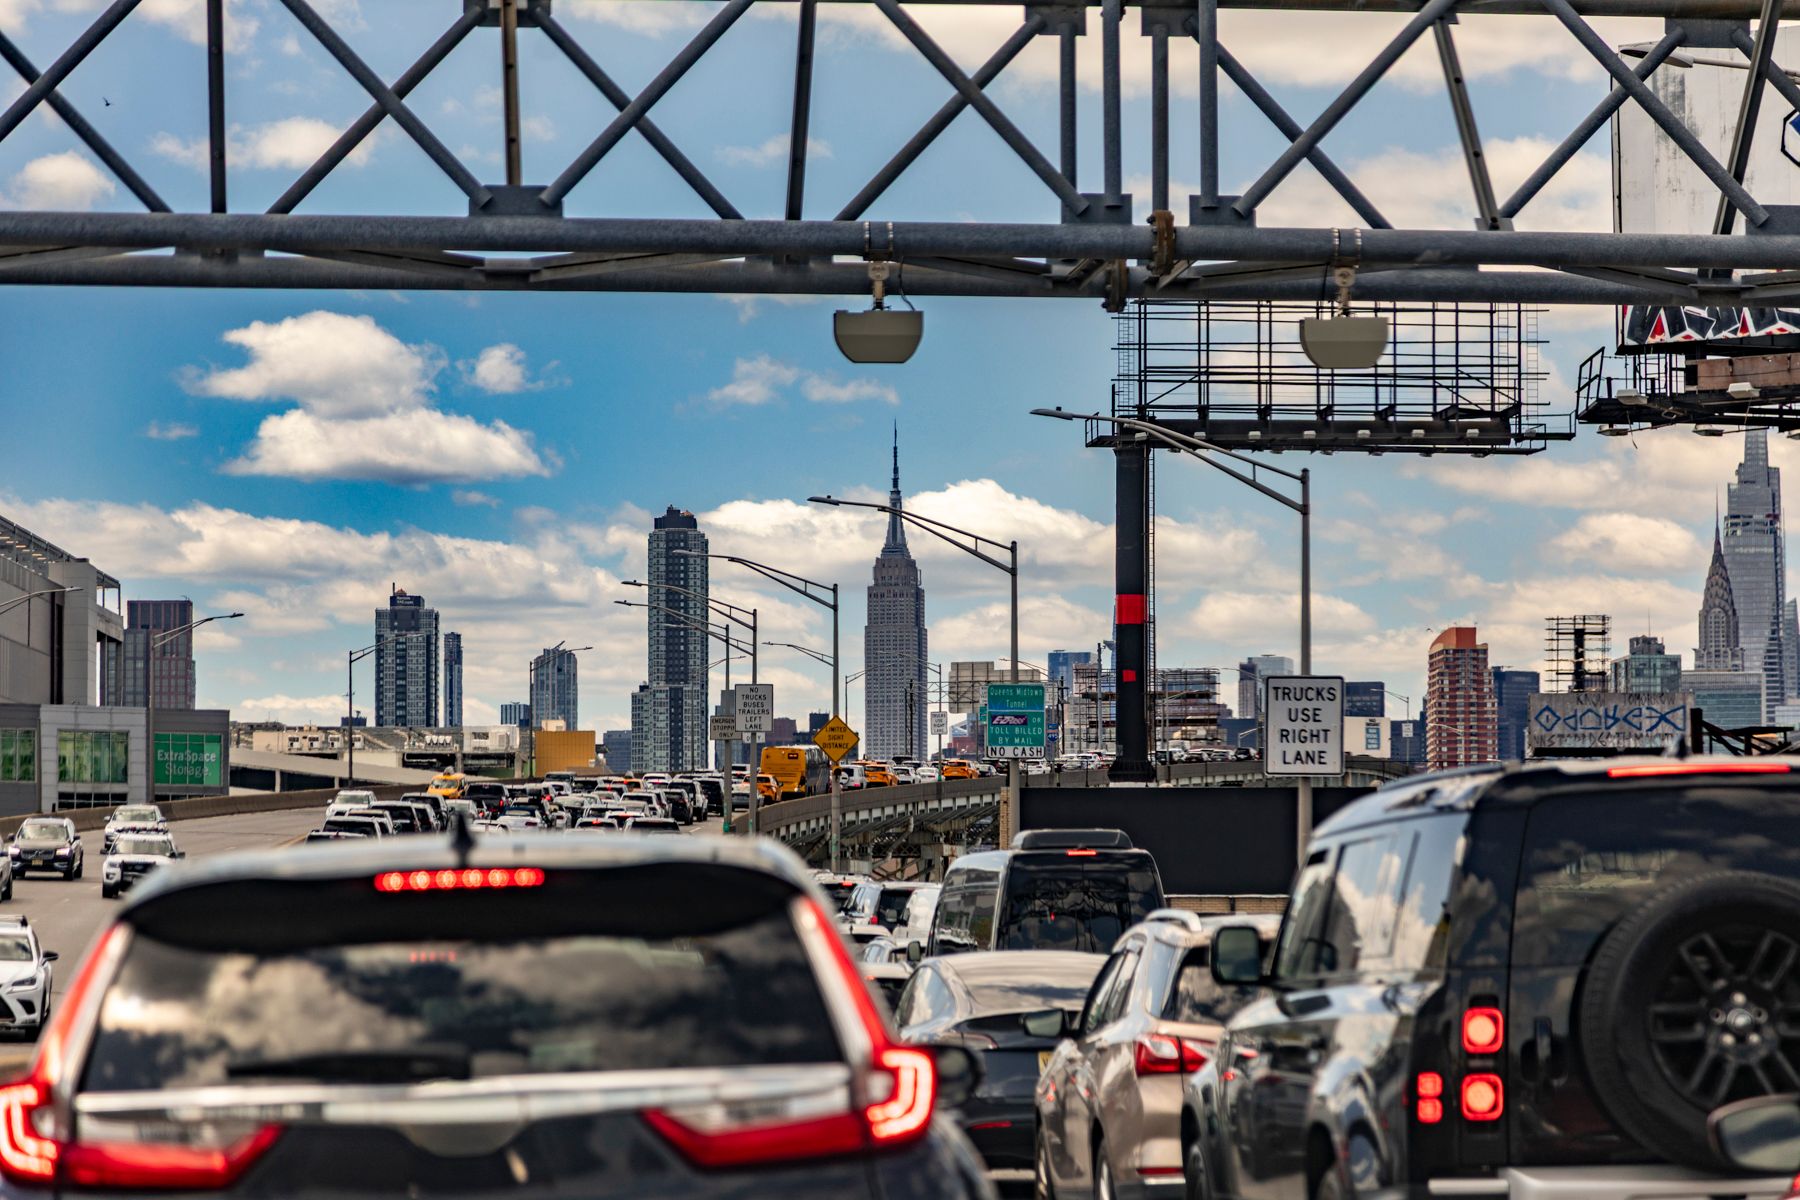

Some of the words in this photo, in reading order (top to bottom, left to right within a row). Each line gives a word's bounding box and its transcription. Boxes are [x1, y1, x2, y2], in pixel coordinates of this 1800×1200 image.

[1016, 688, 1043, 696] Midtown
[1272, 687, 1337, 701] TRUCKS
[1006, 700, 1028, 708] Tunnel
[1288, 708, 1322, 722] USE
[1280, 729, 1331, 744] RIGHT
[990, 747, 1006, 756] NO
[1012, 747, 1042, 756] CASH
[1283, 750, 1328, 765] LANE
